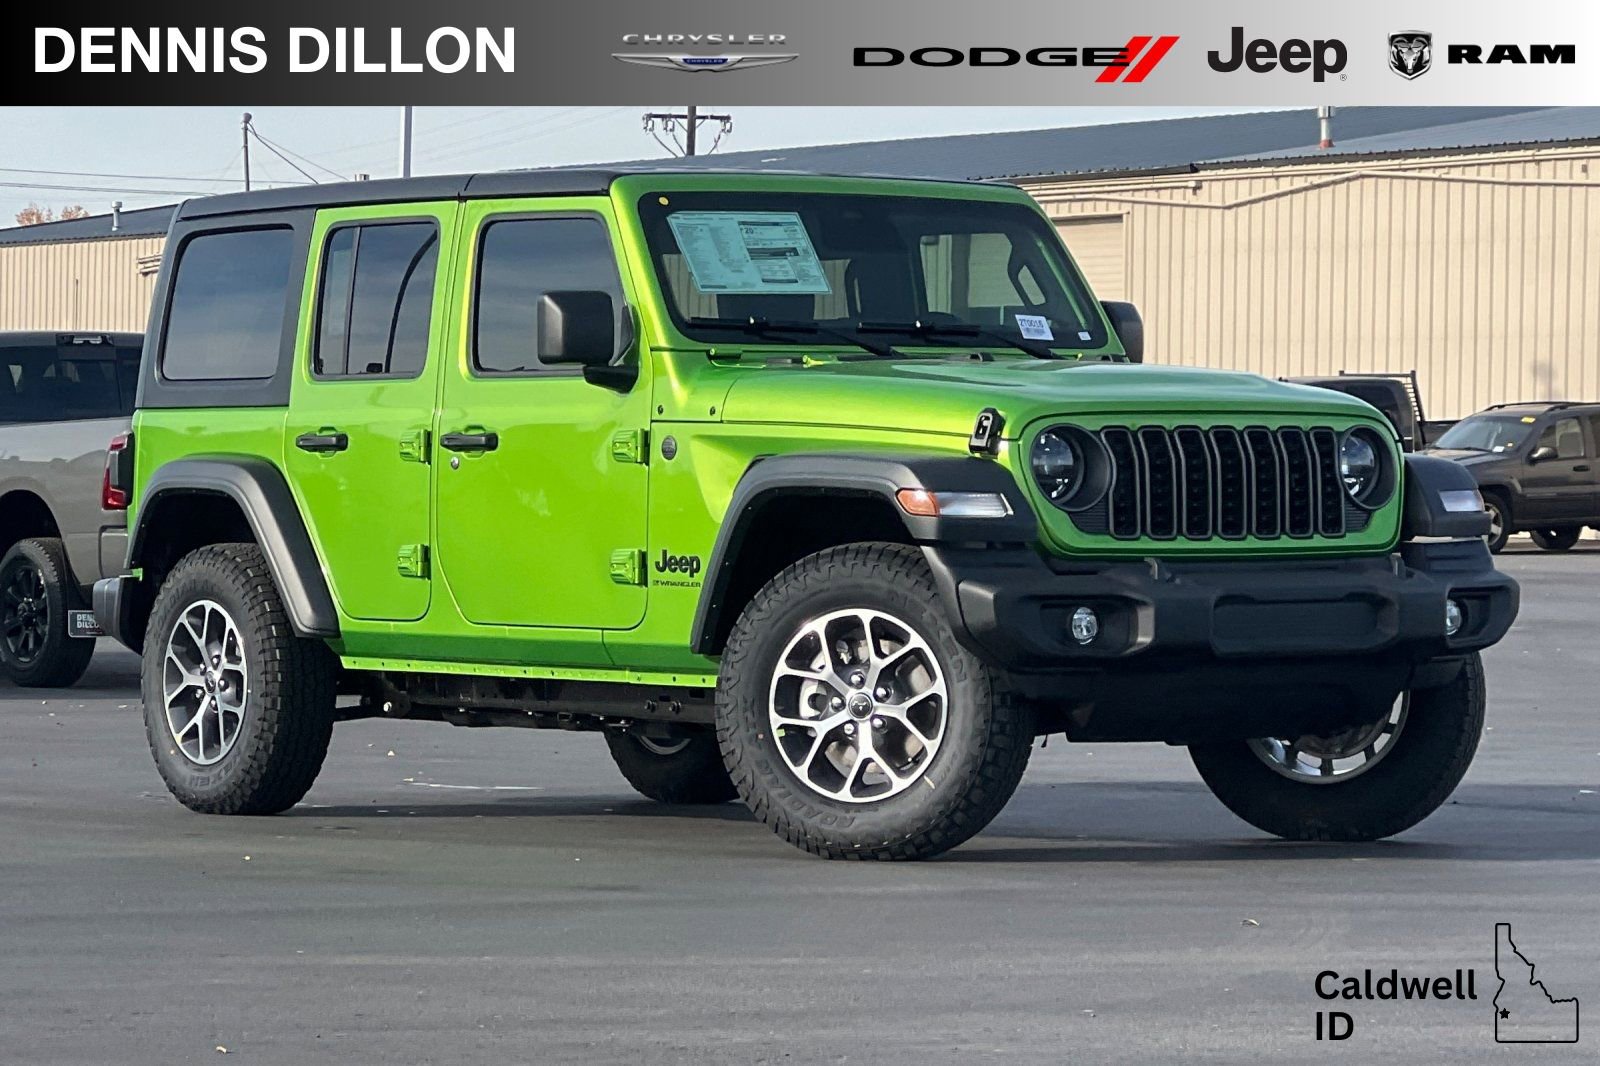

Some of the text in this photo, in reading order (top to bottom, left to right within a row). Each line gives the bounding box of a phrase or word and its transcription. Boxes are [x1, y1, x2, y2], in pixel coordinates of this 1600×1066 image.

[654, 549, 701, 578] Jeep
[660, 580, 701, 588] WRANGLER
[76, 613, 95, 621] DEN
[76, 621, 100, 629] DILLO
